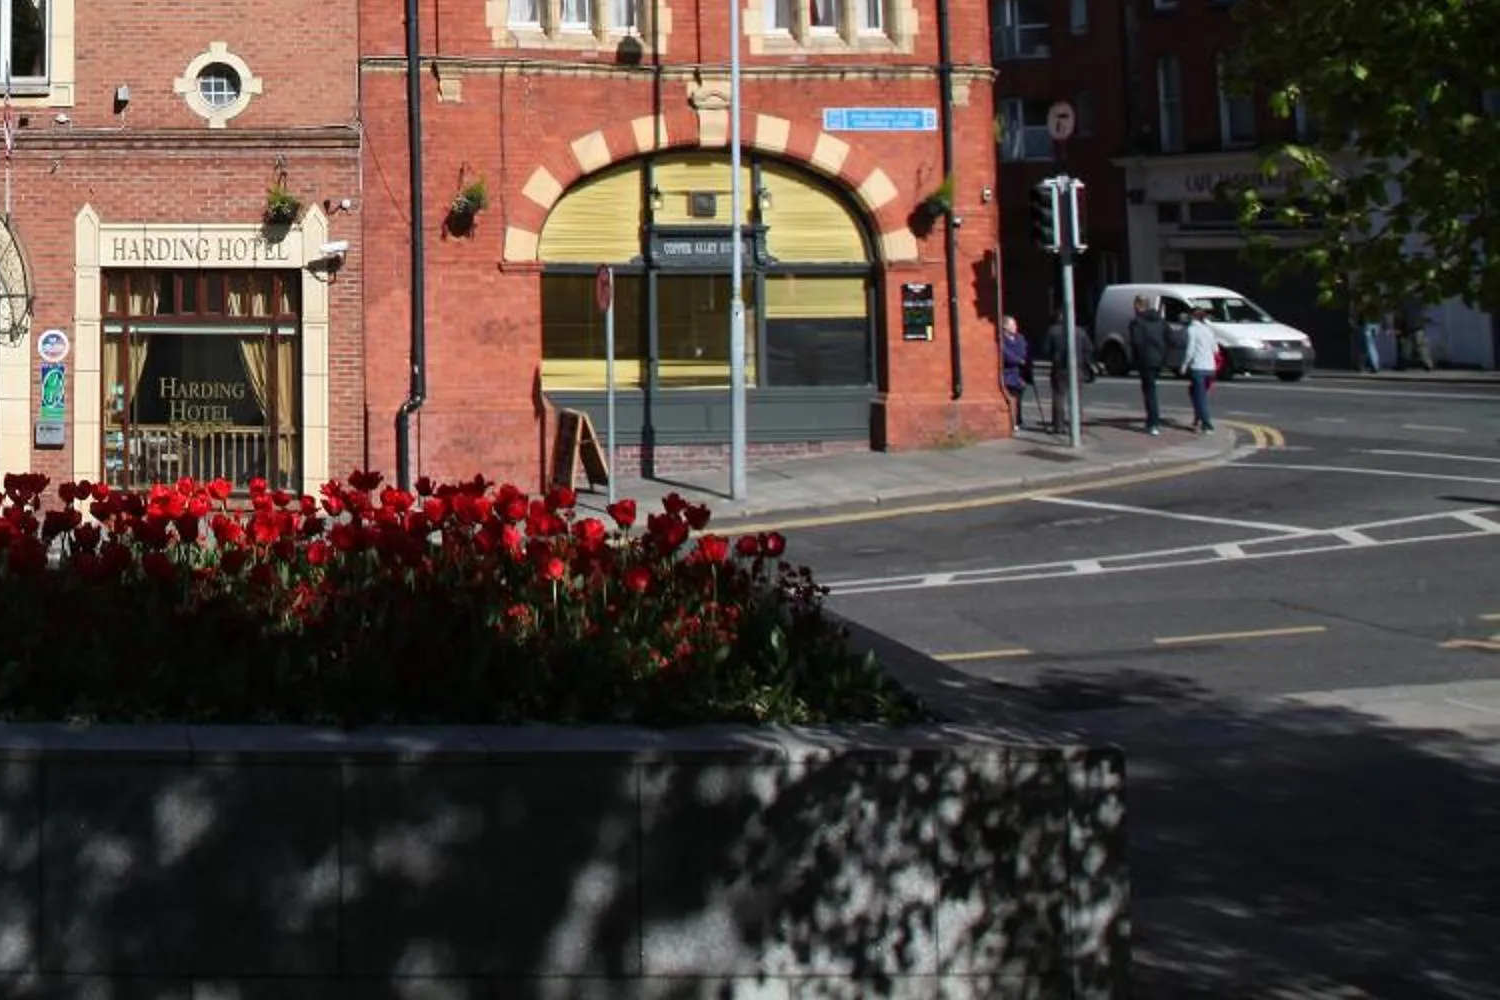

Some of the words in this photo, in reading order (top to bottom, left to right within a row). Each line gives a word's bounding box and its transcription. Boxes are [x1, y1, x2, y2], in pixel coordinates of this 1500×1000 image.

[112, 237, 210, 260] HARDING
[218, 237, 289, 261] HOTEL
[160, 377, 245, 399] HARDING
[170, 400, 231, 421] HOTEL
